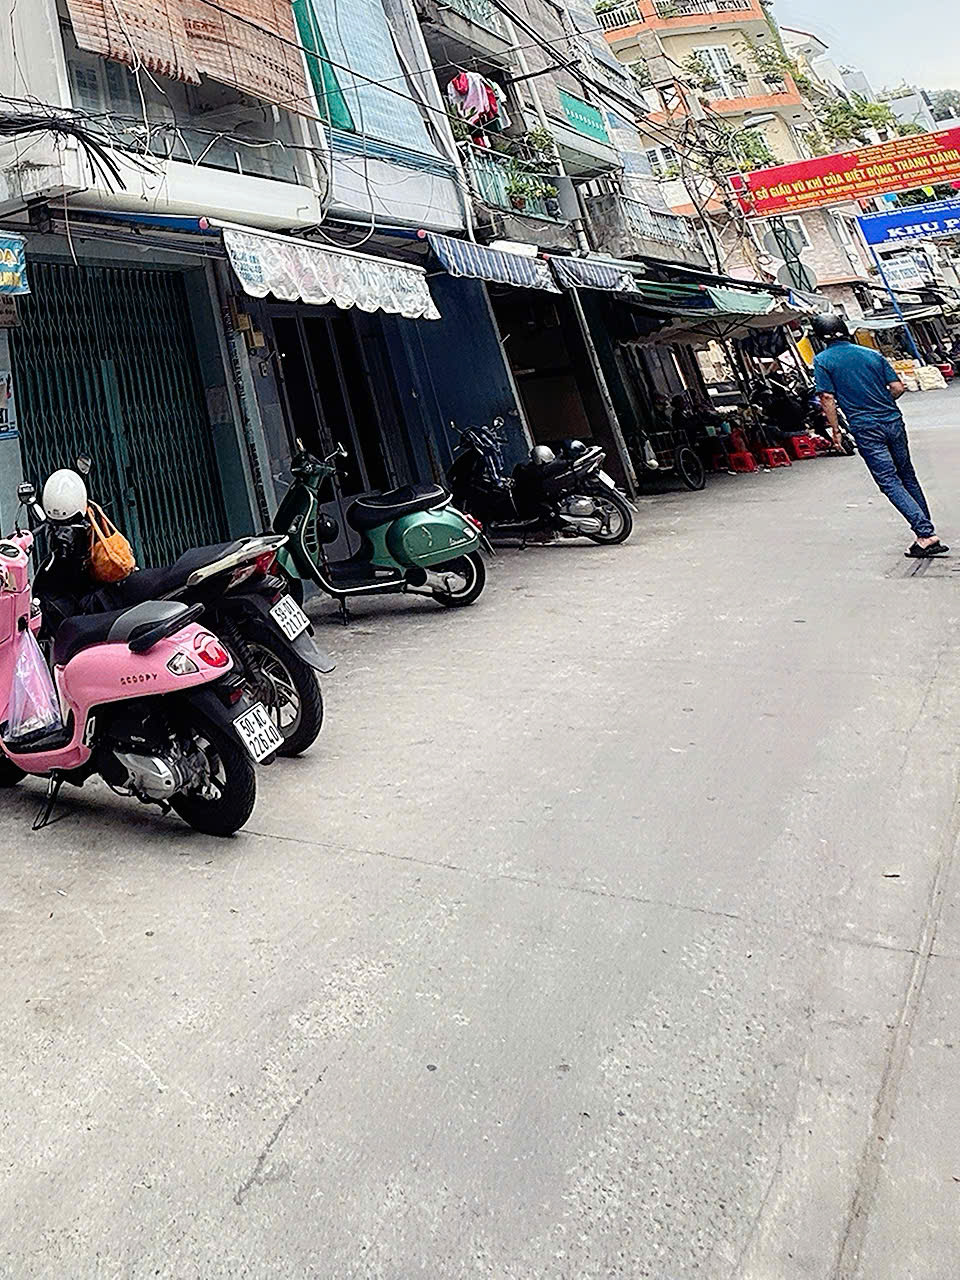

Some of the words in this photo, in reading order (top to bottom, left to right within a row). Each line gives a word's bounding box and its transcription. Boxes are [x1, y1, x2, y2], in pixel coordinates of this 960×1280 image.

[825, 172, 844, 187] CỦA
[845, 168, 866, 184] BIỆT
[867, 163, 895, 180] ĐỘNG
[895, 156, 931, 172] THÀNH
[887, 221, 939, 238] KHU
[248, 726, 280, 759] 226.40
